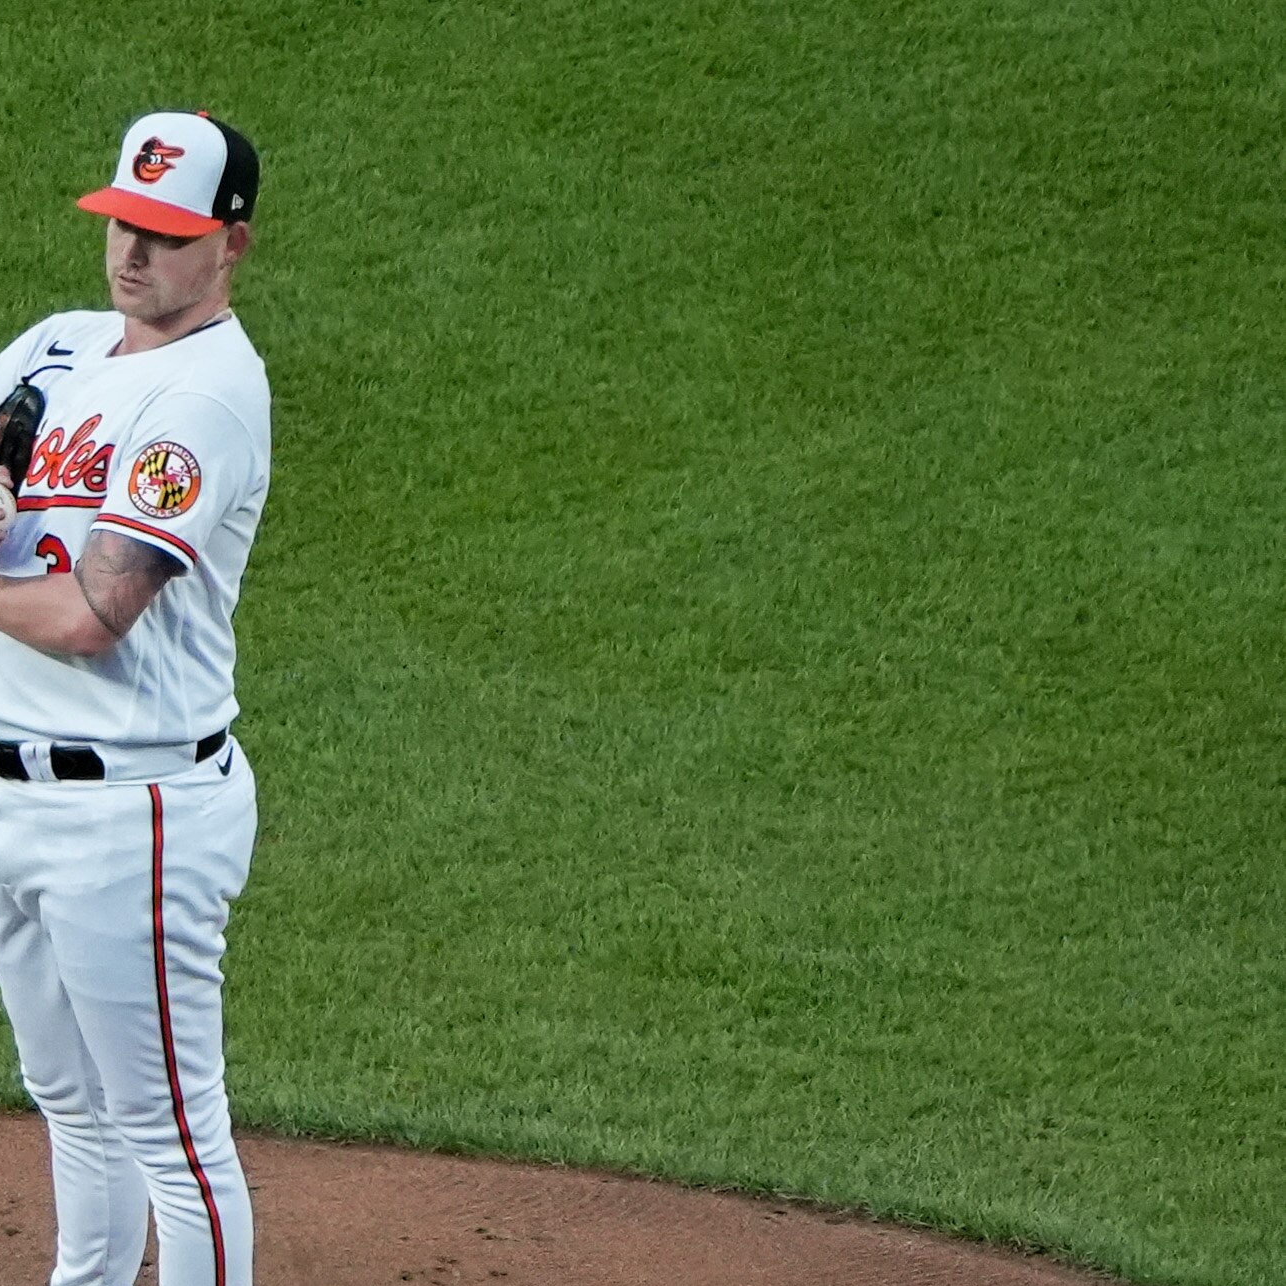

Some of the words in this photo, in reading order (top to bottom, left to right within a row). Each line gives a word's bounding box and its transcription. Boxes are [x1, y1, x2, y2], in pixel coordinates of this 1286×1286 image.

[27, 413, 115, 492] oles
[138, 443, 200, 477] BALTIMORE
[131, 493, 181, 517] ORIOLES
